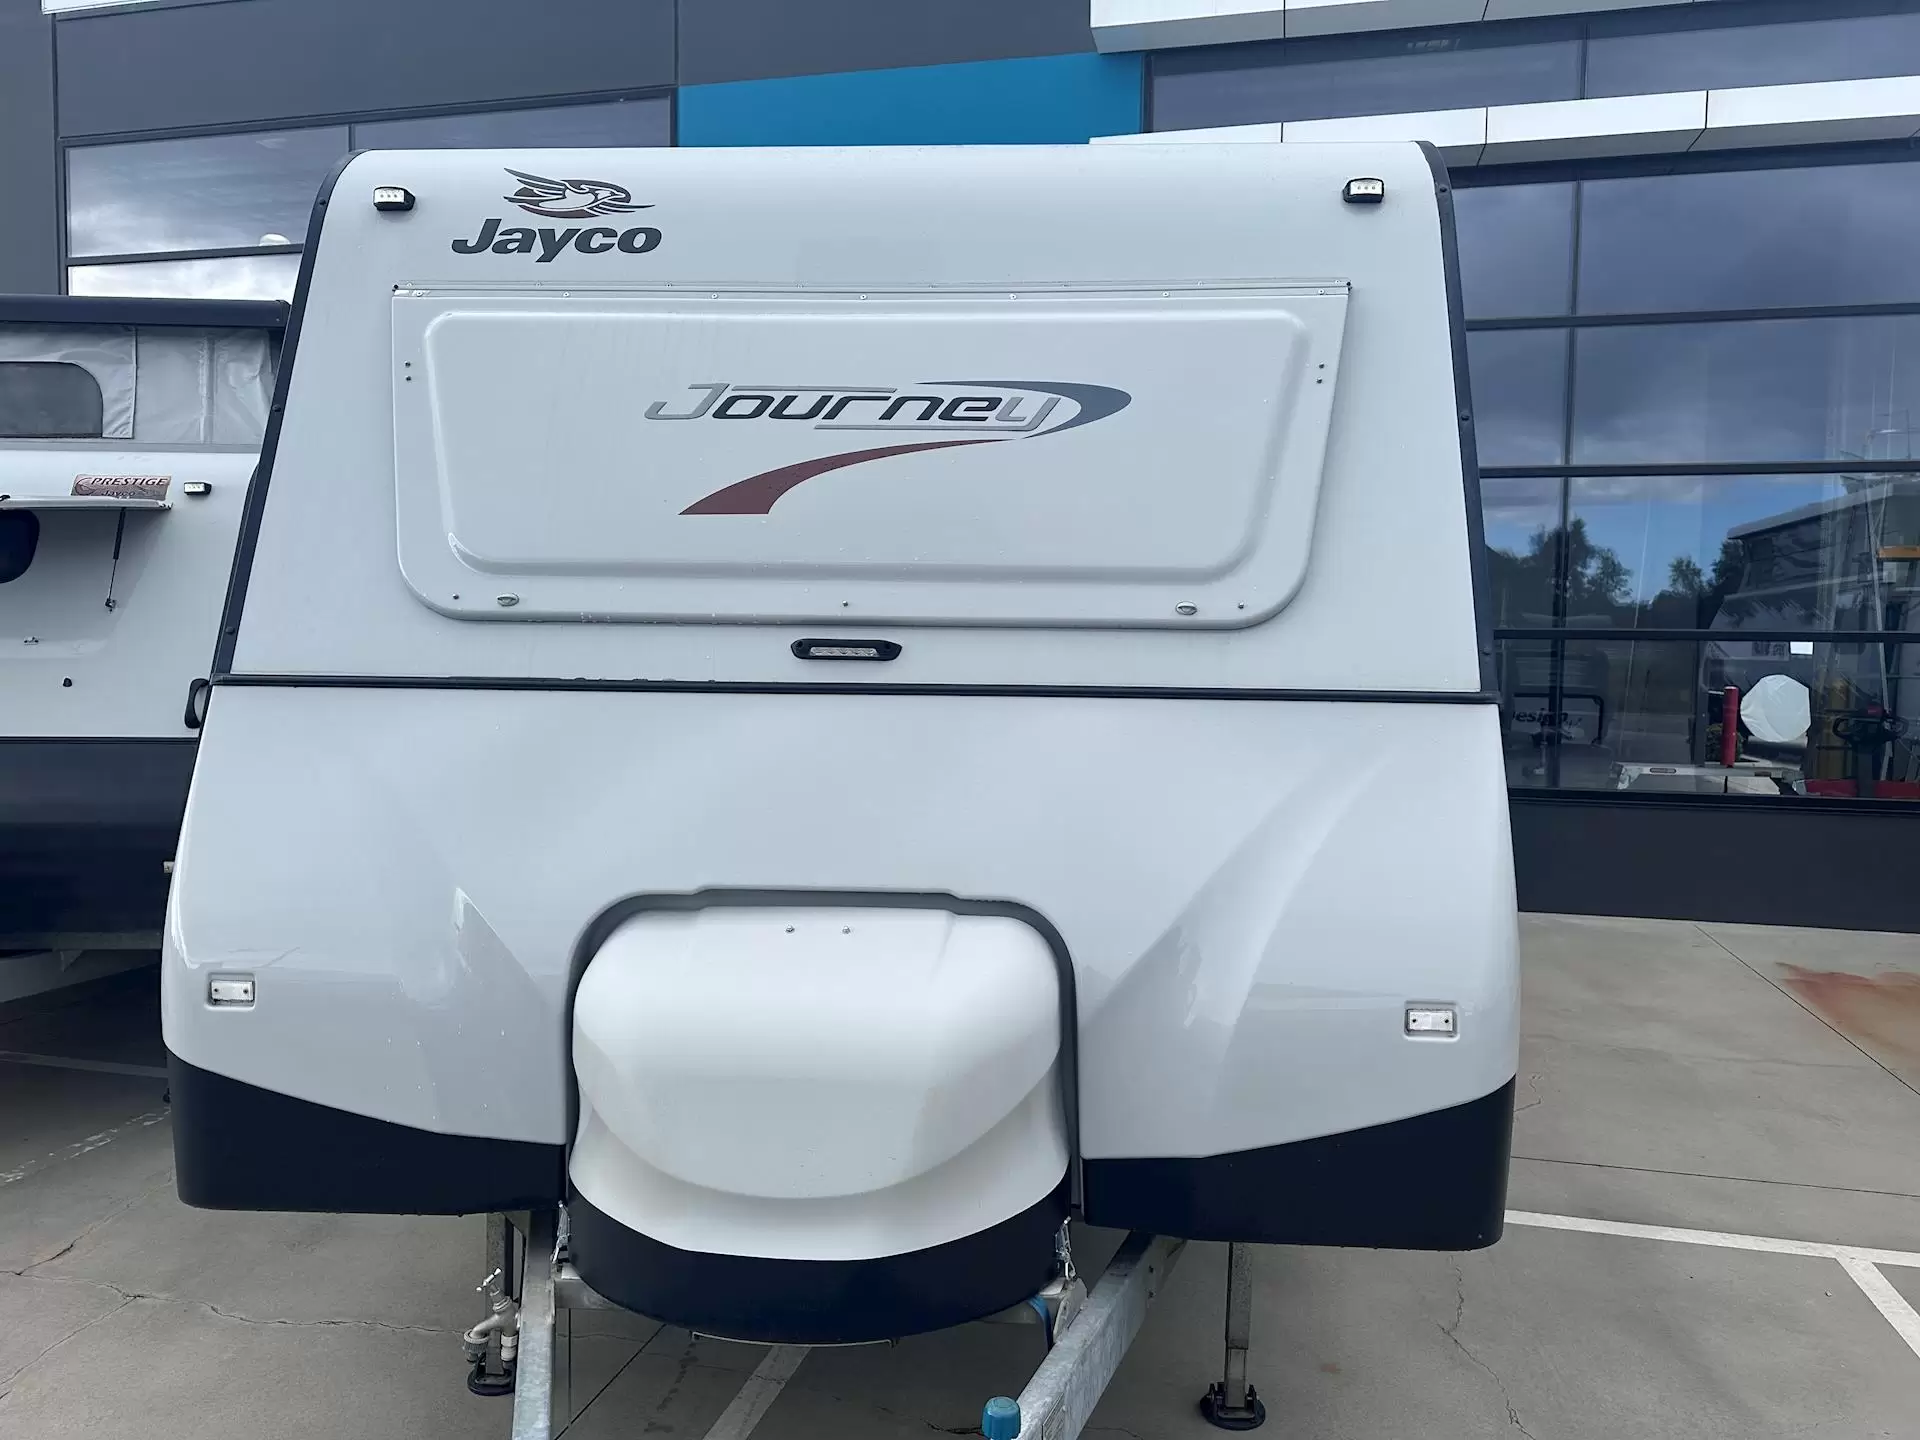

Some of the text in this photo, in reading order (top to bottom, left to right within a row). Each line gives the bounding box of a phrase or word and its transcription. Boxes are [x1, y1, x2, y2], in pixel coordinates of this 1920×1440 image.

[451, 218, 662, 263] Jayco
[643, 382, 1062, 431] Journey
[91, 477, 168, 486] PRESTIGE
